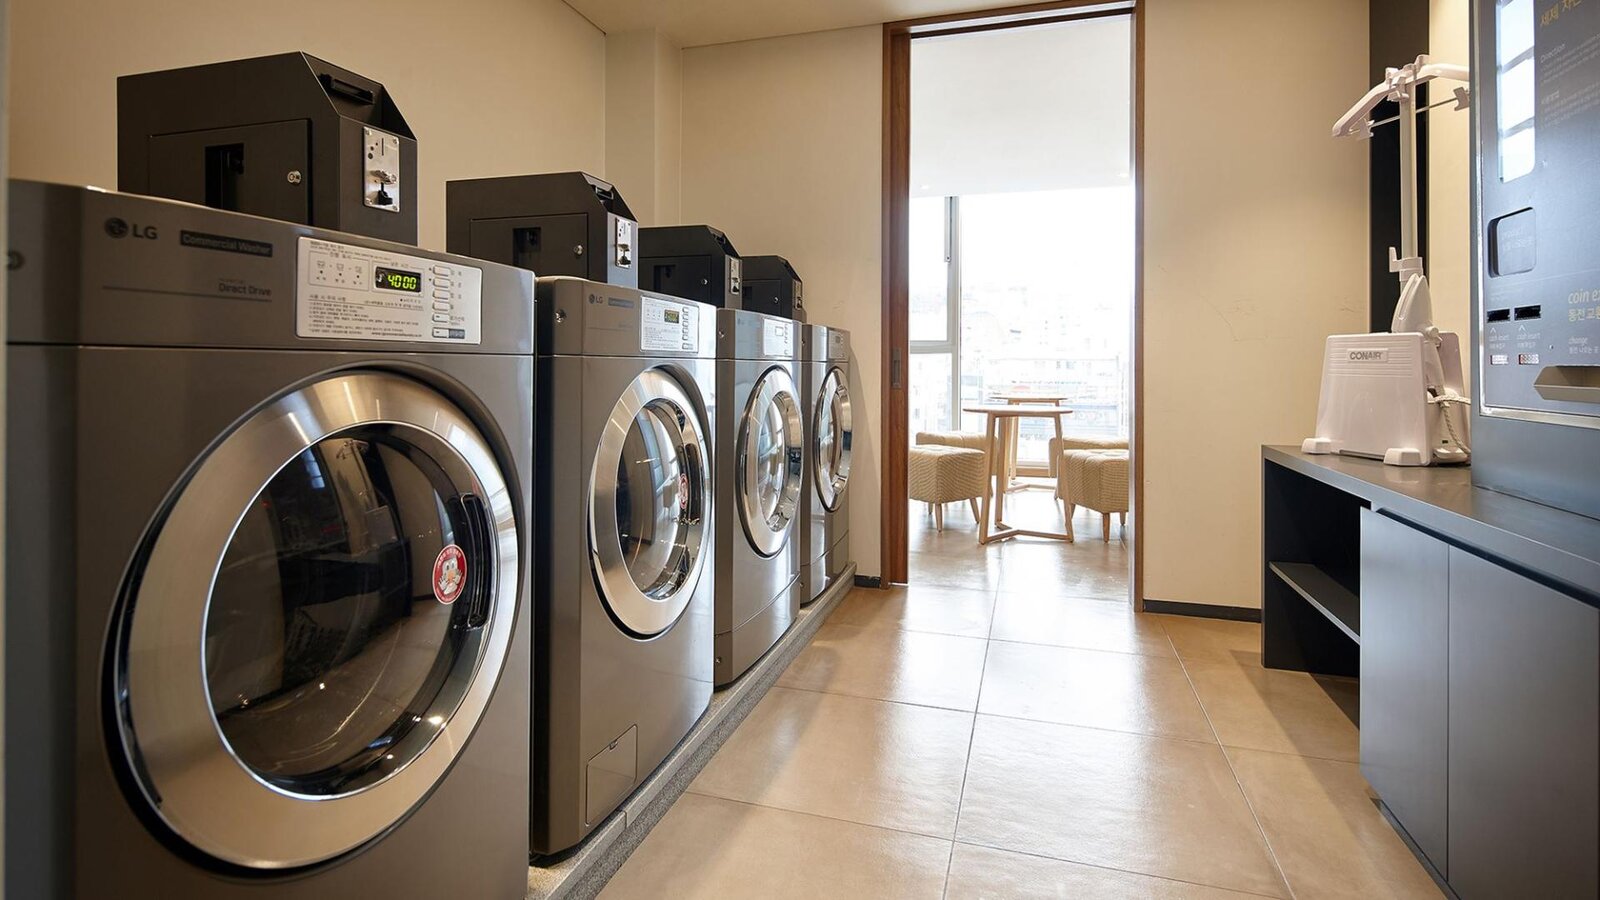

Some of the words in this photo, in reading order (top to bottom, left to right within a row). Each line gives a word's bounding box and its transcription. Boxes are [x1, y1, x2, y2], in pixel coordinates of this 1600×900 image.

[132, 224, 158, 240] LG
[183, 234, 238, 250] Commercial
[239, 242, 271, 254] Washer
[219, 283, 246, 294] Direct
[248, 285, 272, 297] Drive
[1568, 287, 1589, 305] coin
[595, 296, 604, 304] LG
[1350, 351, 1382, 361] CONAIR
